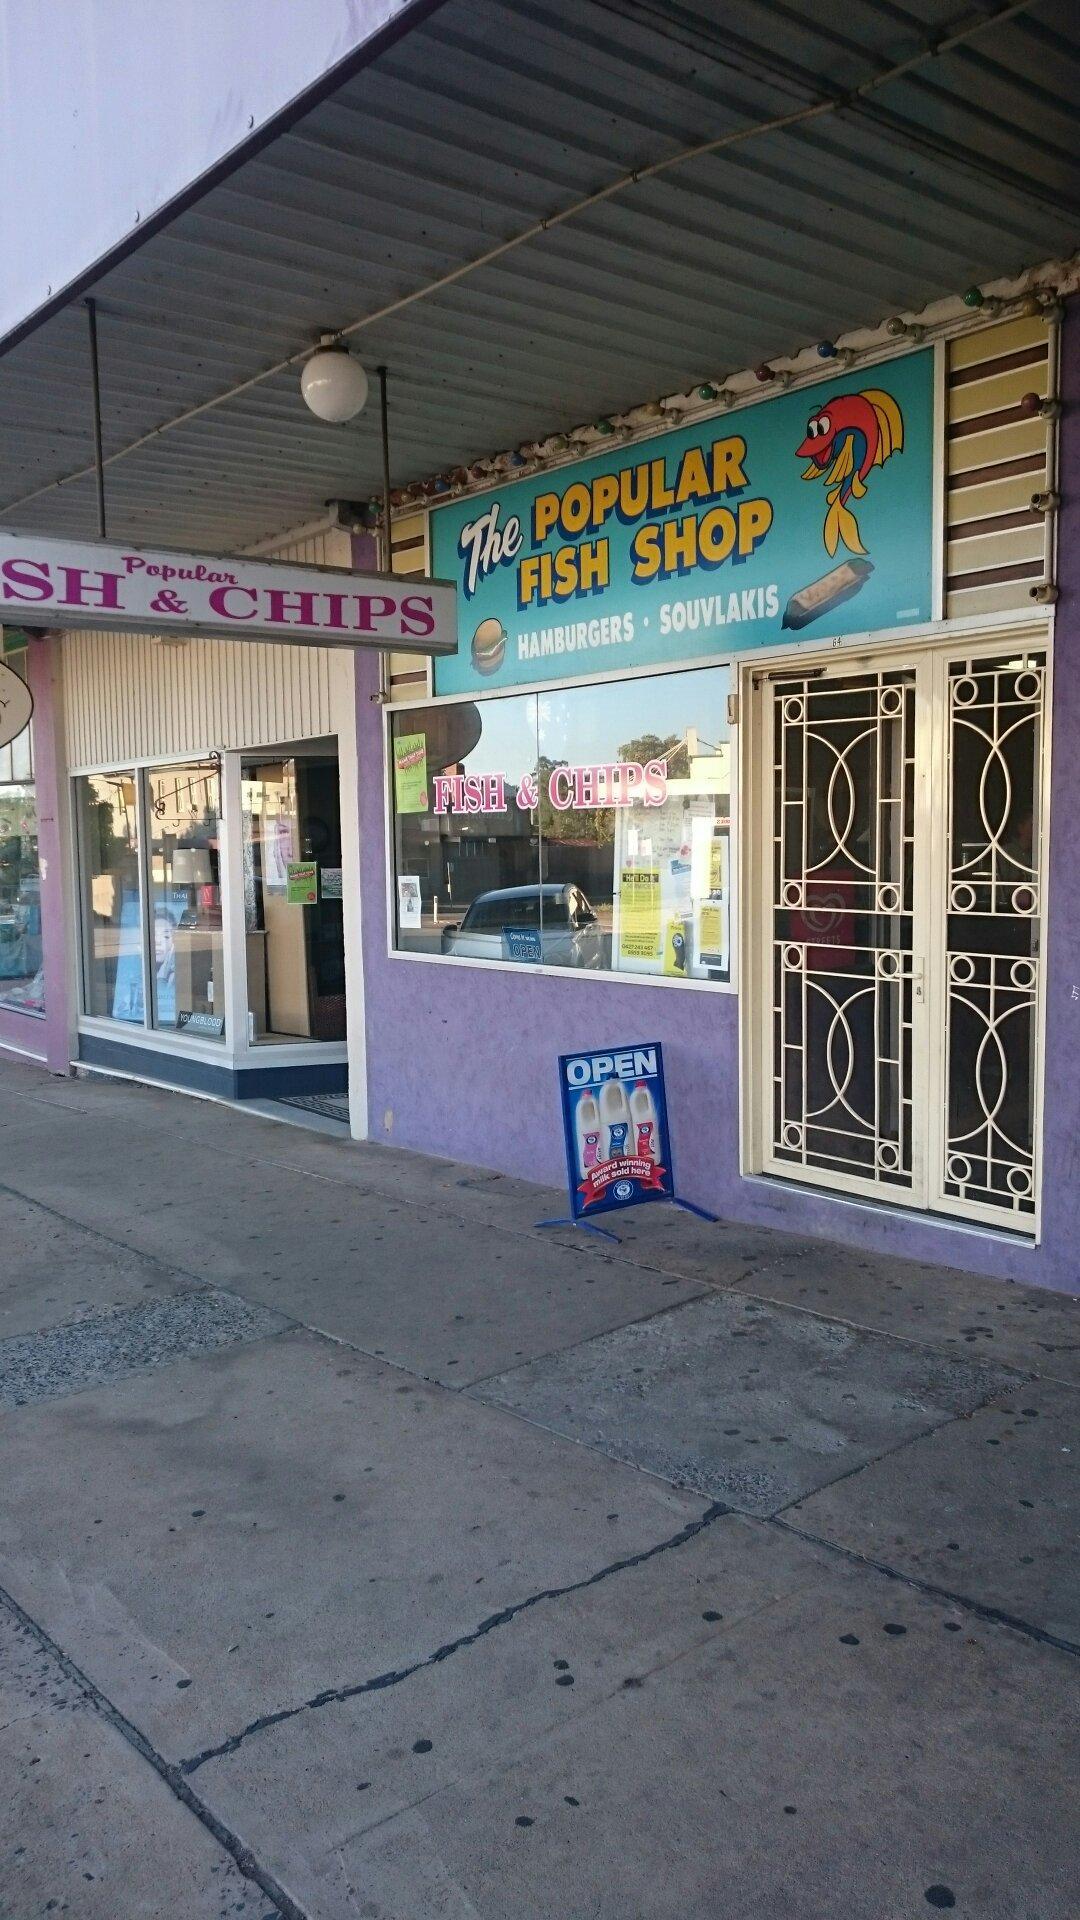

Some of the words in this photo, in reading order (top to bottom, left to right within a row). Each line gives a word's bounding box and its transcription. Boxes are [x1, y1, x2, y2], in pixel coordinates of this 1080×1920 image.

[460, 502, 523, 596] The
[533, 435, 750, 546] POPULAR
[518, 536, 610, 606] FISH
[632, 497, 774, 583] SHOP
[121, 556, 238, 585] Popular
[150, 589, 189, 614] &
[208, 586, 436, 636] CHIPS
[517, 611, 634, 660] HAMBURGERS
[659, 584, 779, 635] SOUVLAKIS
[433, 772, 507, 814] FISH
[516, 773, 539, 810] &
[548, 759, 668, 811] CHIPS
[513, 944, 542, 959] OPEN
[180, 1013, 221, 1027] YOUNGBLOOD
[567, 1050, 657, 1085] OPEN
[591, 1161, 618, 1181] Award
[619, 1159, 651, 1170] winning
[593, 1173, 610, 1188] milk
[611, 1167, 629, 1178] sold
[631, 1167, 651, 1176] here
